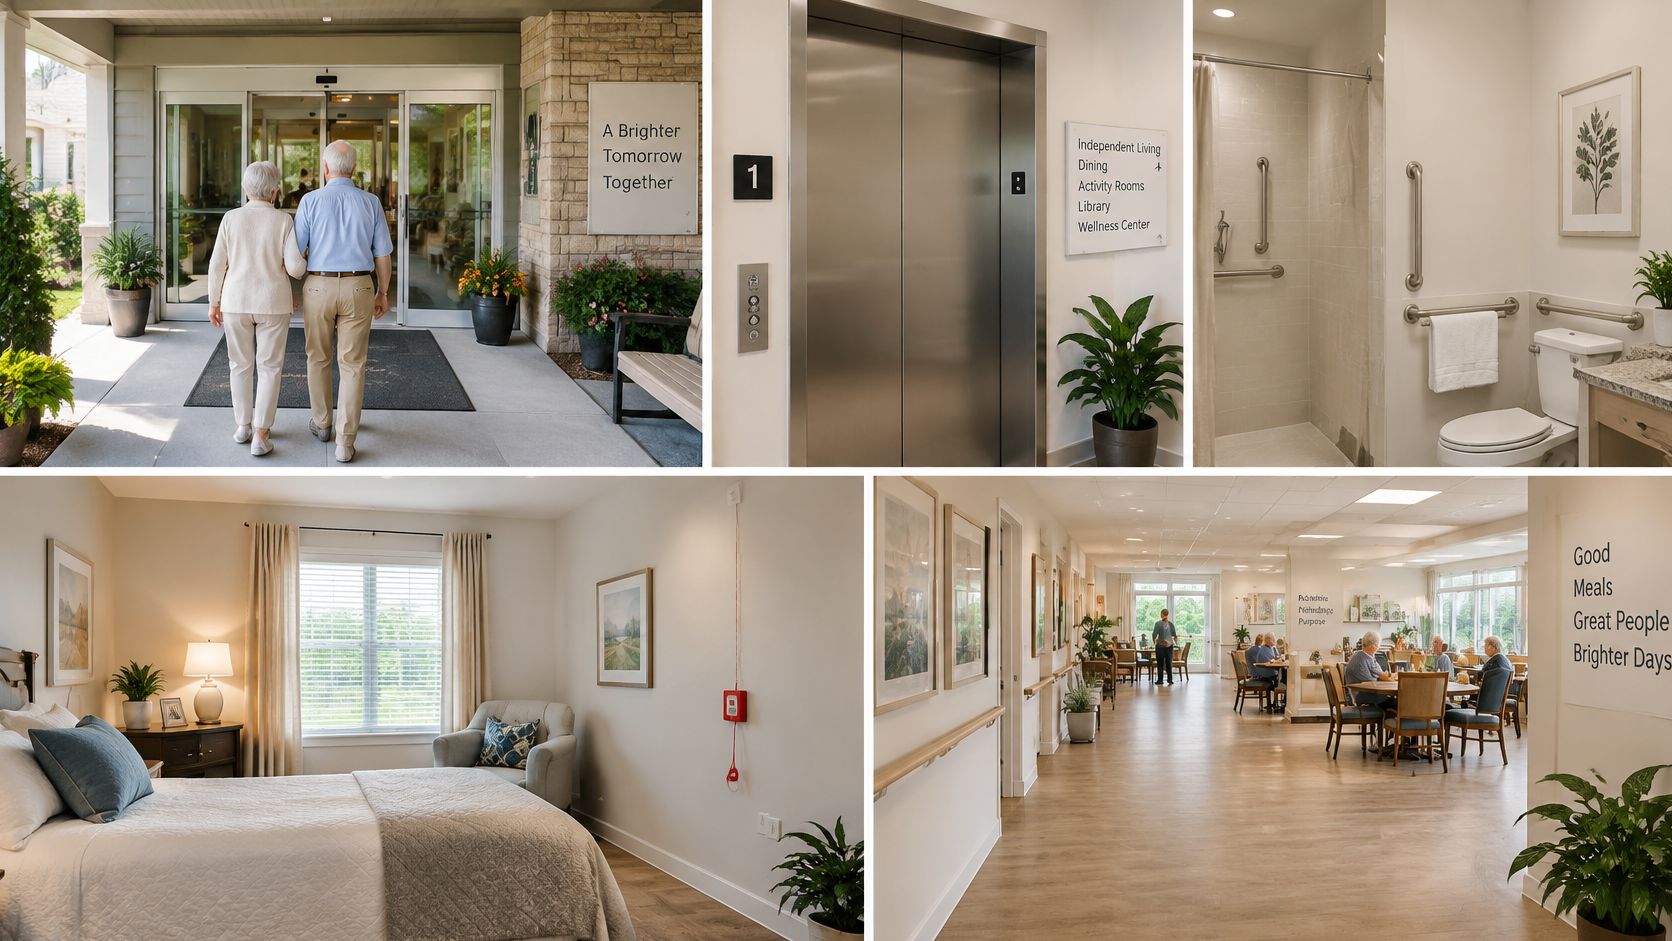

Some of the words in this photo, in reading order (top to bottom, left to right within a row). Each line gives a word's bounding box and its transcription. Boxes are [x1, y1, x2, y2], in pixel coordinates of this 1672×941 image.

[603, 123, 613, 138] A
[618, 123, 681, 141] Brighter
[602, 148, 682, 163] Tomorrow
[1078, 138, 1135, 154] Independent
[1137, 142, 1161, 157] Living
[1078, 159, 1108, 174] Dining
[602, 174, 672, 193] Together
[747, 164, 758, 189] 1
[1078, 180, 1112, 194] Activity
[1114, 180, 1145, 192] Rooms
[1078, 200, 1111, 214] Library
[1078, 220, 1119, 232] Wellness
[1121, 219, 1150, 231] Center
[1573, 541, 1610, 566] Good
[1574, 577, 1613, 597] Meals
[1298, 617, 1326, 627] Purpose
[1573, 610, 1612, 630] Great
[1616, 609, 1670, 637] People
[1574, 643, 1629, 669] Brighter
[1634, 646, 1672, 676] Days
